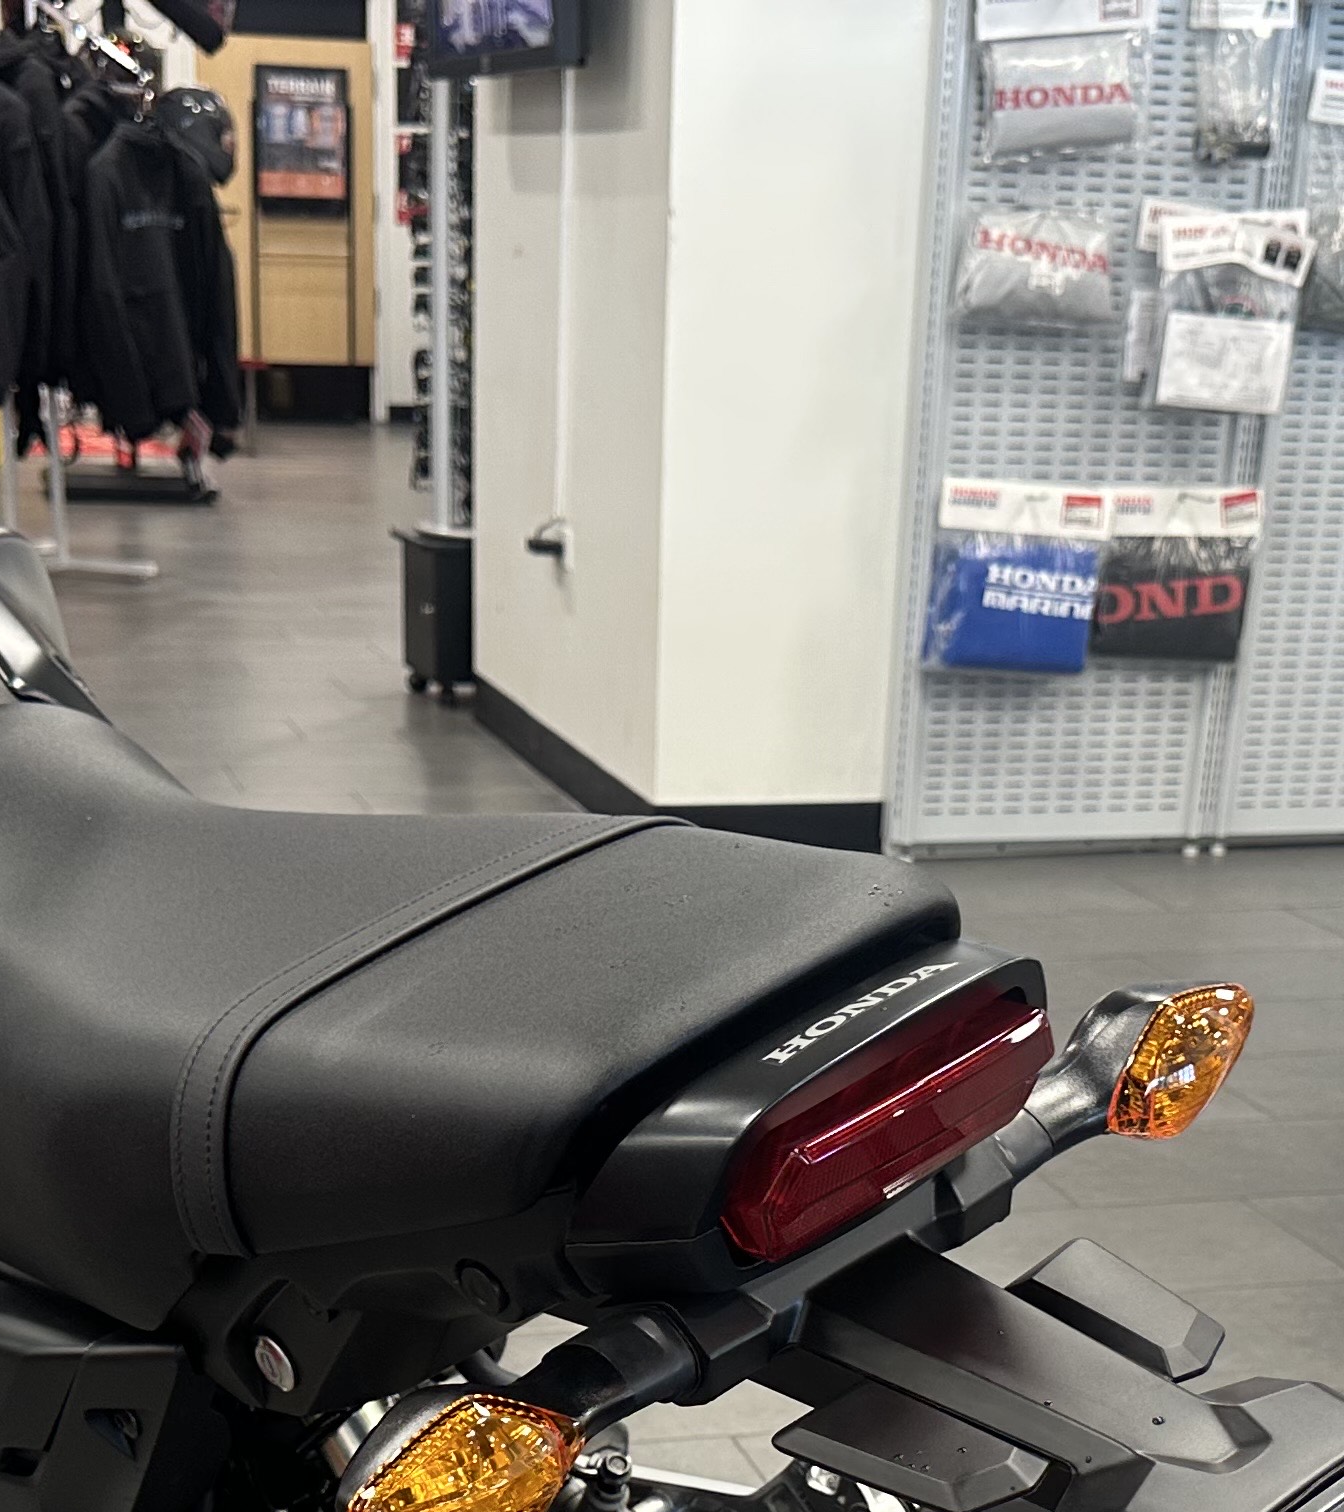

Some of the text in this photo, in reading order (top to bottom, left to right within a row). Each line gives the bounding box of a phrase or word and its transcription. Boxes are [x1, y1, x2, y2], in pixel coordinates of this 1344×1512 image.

[994, 82, 1133, 111] HONDA
[978, 227, 1110, 274] HONDA
[761, 960, 960, 1064] HONDA
